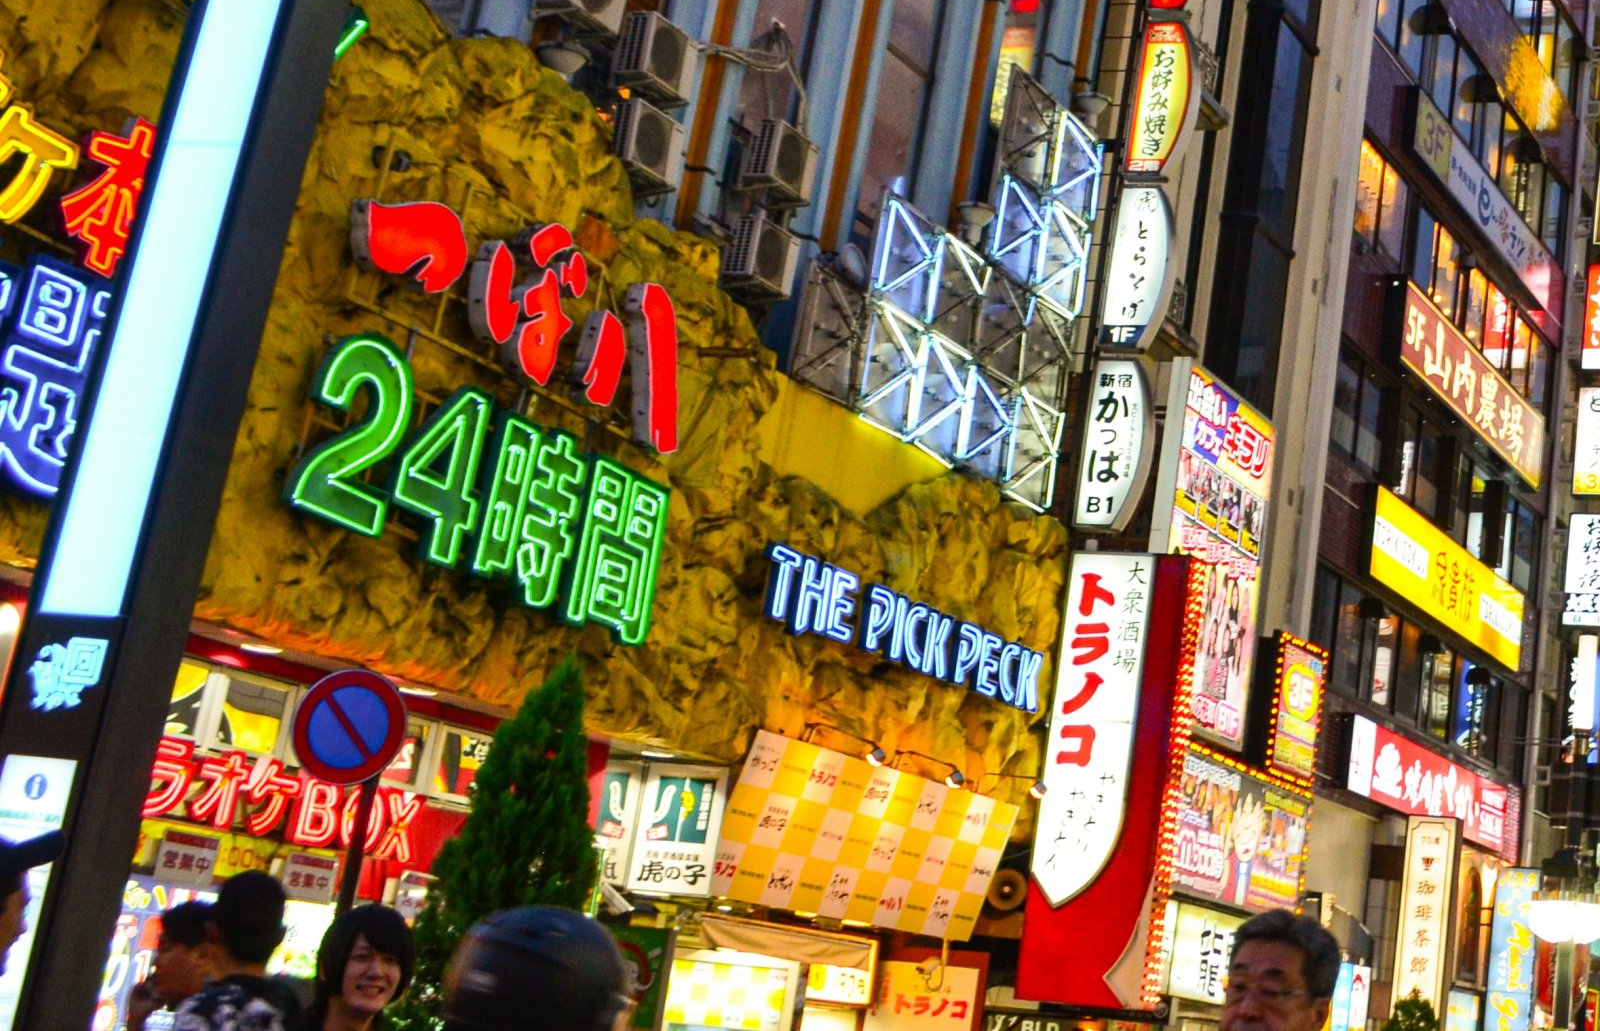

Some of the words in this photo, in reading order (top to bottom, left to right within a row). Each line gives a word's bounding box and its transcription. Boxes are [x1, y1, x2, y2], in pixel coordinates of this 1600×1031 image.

[1141, 48, 1175, 156] お好み焼き
[1109, 326, 1137, 343] 1F
[1404, 304, 1427, 353] 5F
[1099, 373, 1133, 389] 新宿
[1424, 331, 1525, 465] 山内農場
[1087, 391, 1130, 484] かっぱ
[292, 334, 668, 645] 24時間
[1086, 496, 1114, 514] B1
[769, 544, 858, 643] THE
[865, 585, 954, 681] PICK
[956, 624, 1045, 712] PECK
[1114, 561, 1147, 674] 大衆酒場
[1057, 572, 1116, 767] トラノコ
[161, 850, 211, 874] 営業中
[287, 870, 329, 893] 営業中
[636, 860, 706, 886] 虎の子
[893, 992, 969, 1020] トラノコ
